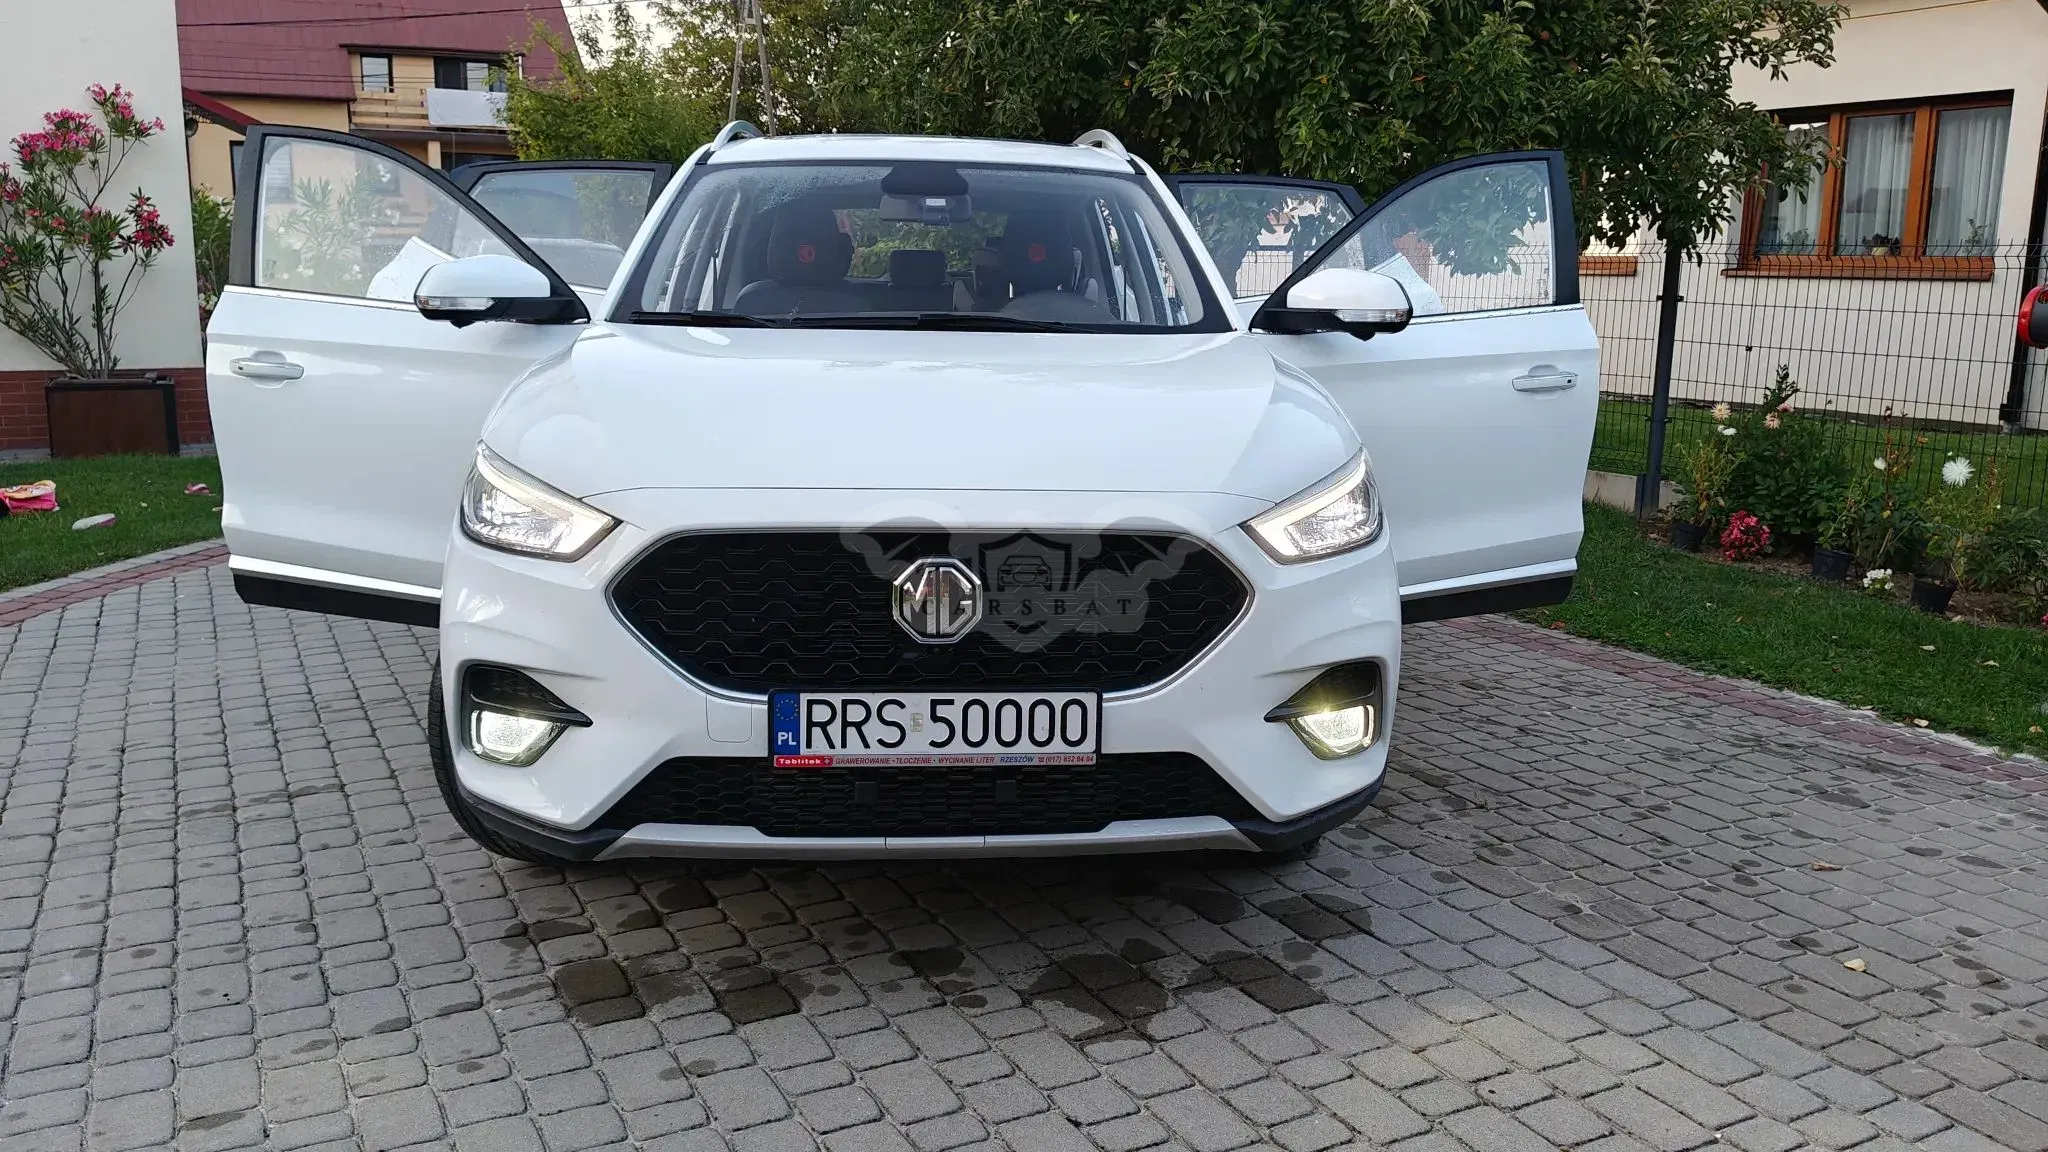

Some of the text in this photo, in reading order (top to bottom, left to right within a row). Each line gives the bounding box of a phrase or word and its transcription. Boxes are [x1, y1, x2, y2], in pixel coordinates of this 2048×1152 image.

[903, 566, 972, 636] MG
[777, 731, 797, 746] PL
[805, 698, 1089, 749] RRS 50000
[835, 757, 891, 765] GRAWEROWANIE
[976, 756, 995, 764] LITER
[1000, 755, 1035, 763] RZESZÓW
